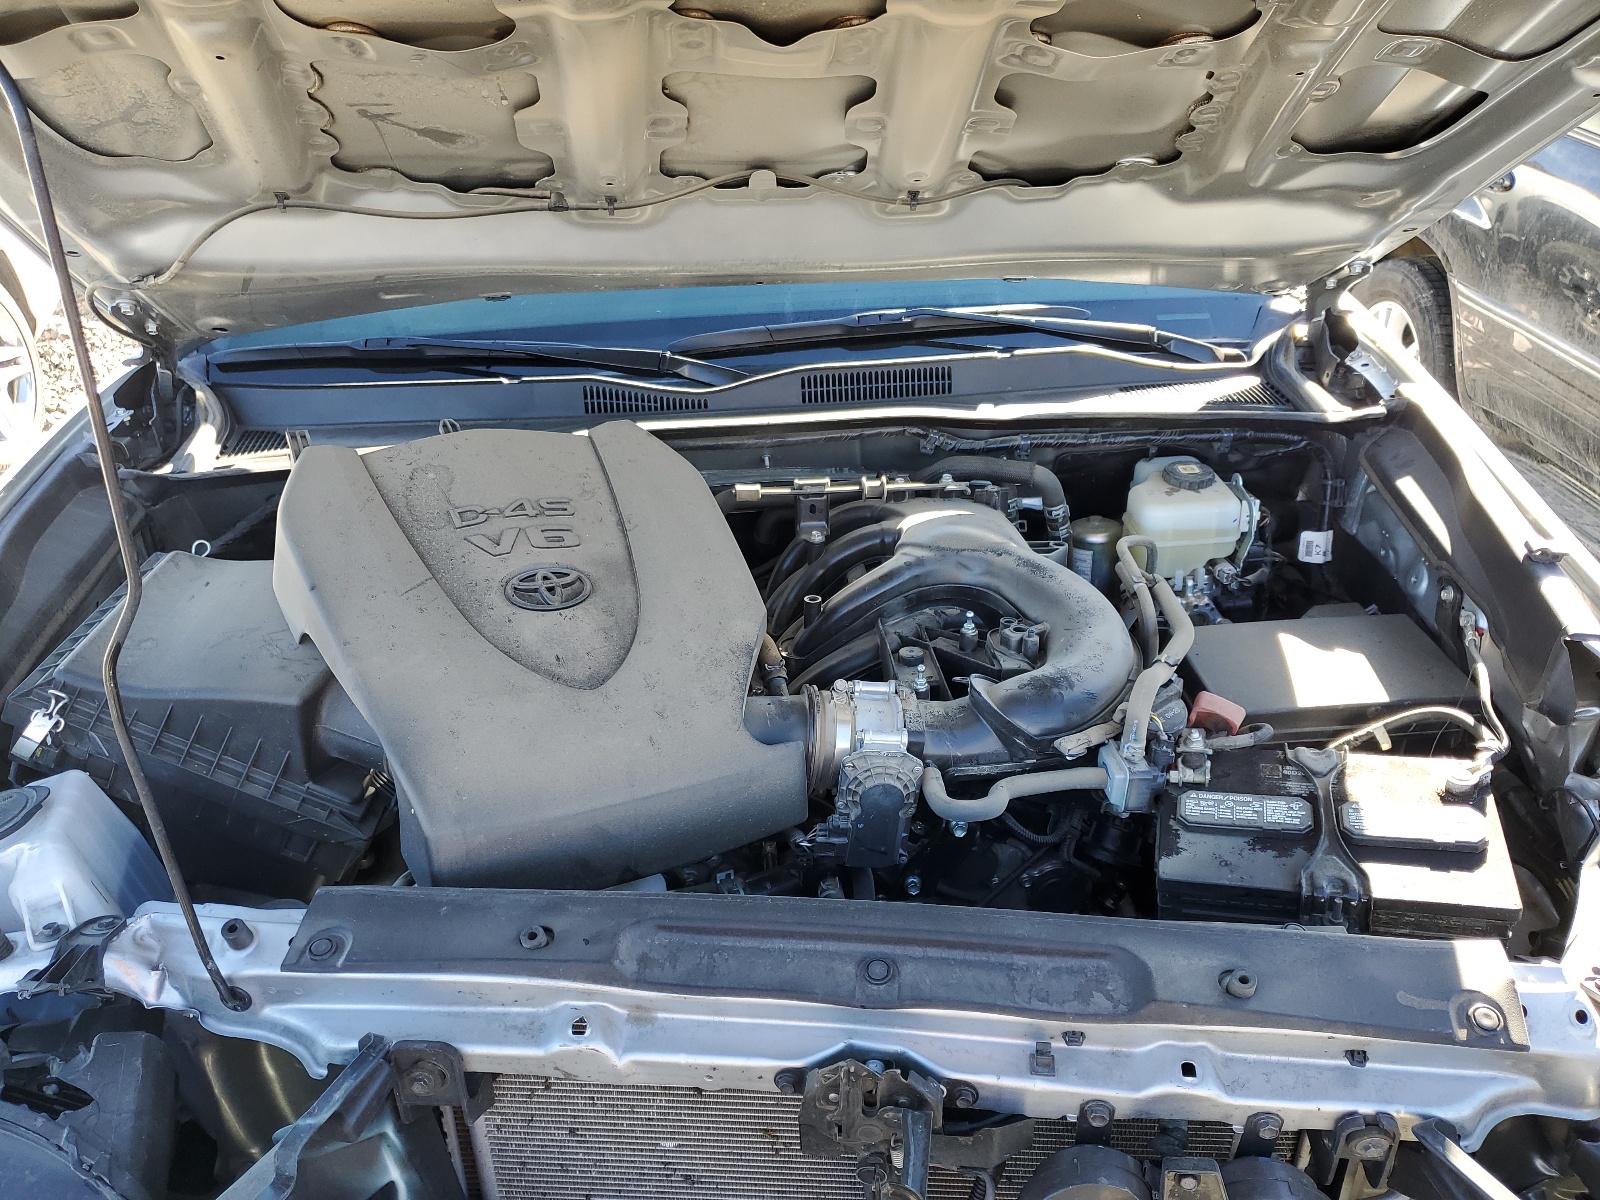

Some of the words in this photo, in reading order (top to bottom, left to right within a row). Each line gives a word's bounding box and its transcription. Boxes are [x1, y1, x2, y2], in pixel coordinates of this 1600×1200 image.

[449, 497, 576, 529] D-4S
[463, 524, 581, 557] V6
[1314, 544, 1322, 556] K7
